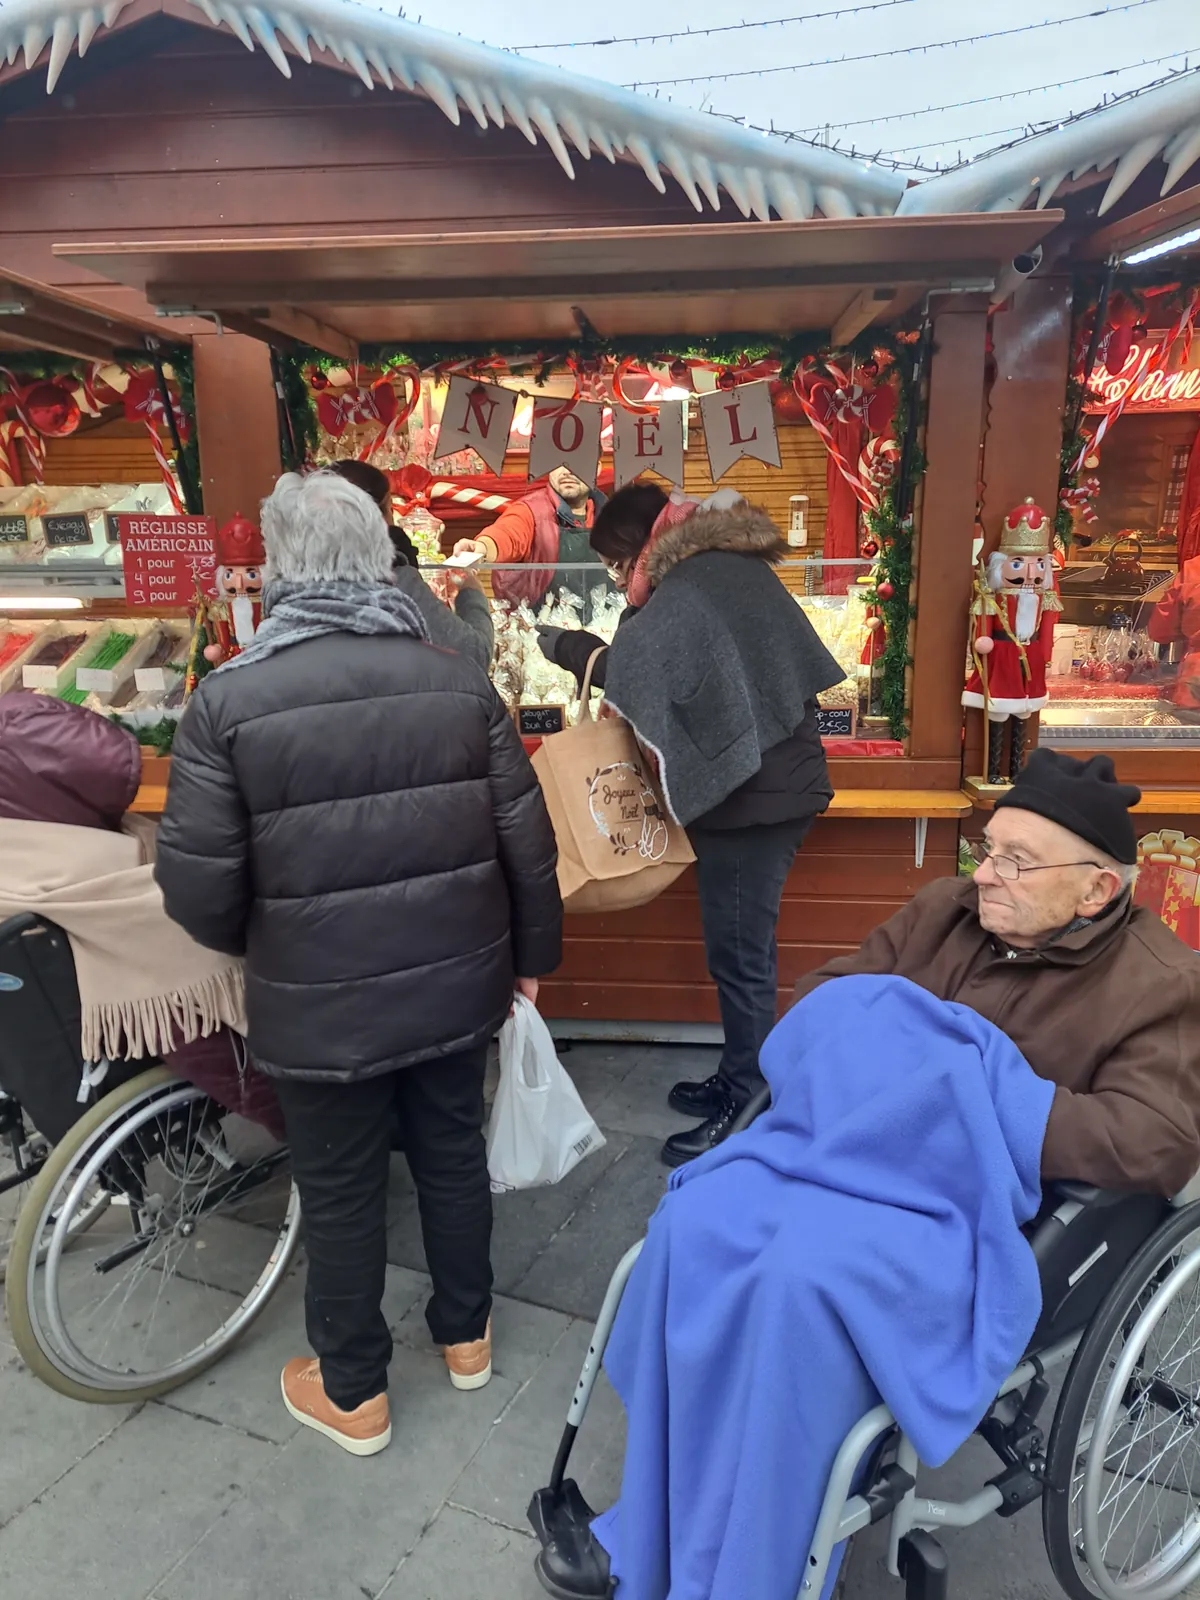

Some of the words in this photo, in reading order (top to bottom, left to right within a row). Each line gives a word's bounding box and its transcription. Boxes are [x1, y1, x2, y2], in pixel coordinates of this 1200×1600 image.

[128, 517, 208, 535] RÉGLISSE
[125, 535, 214, 552] AMÉRICAIN
[136, 557, 143, 568] 1
[147, 559, 175, 571] pour
[134, 573, 143, 585] 4
[148, 575, 176, 587] pour
[150, 592, 178, 603] pour
